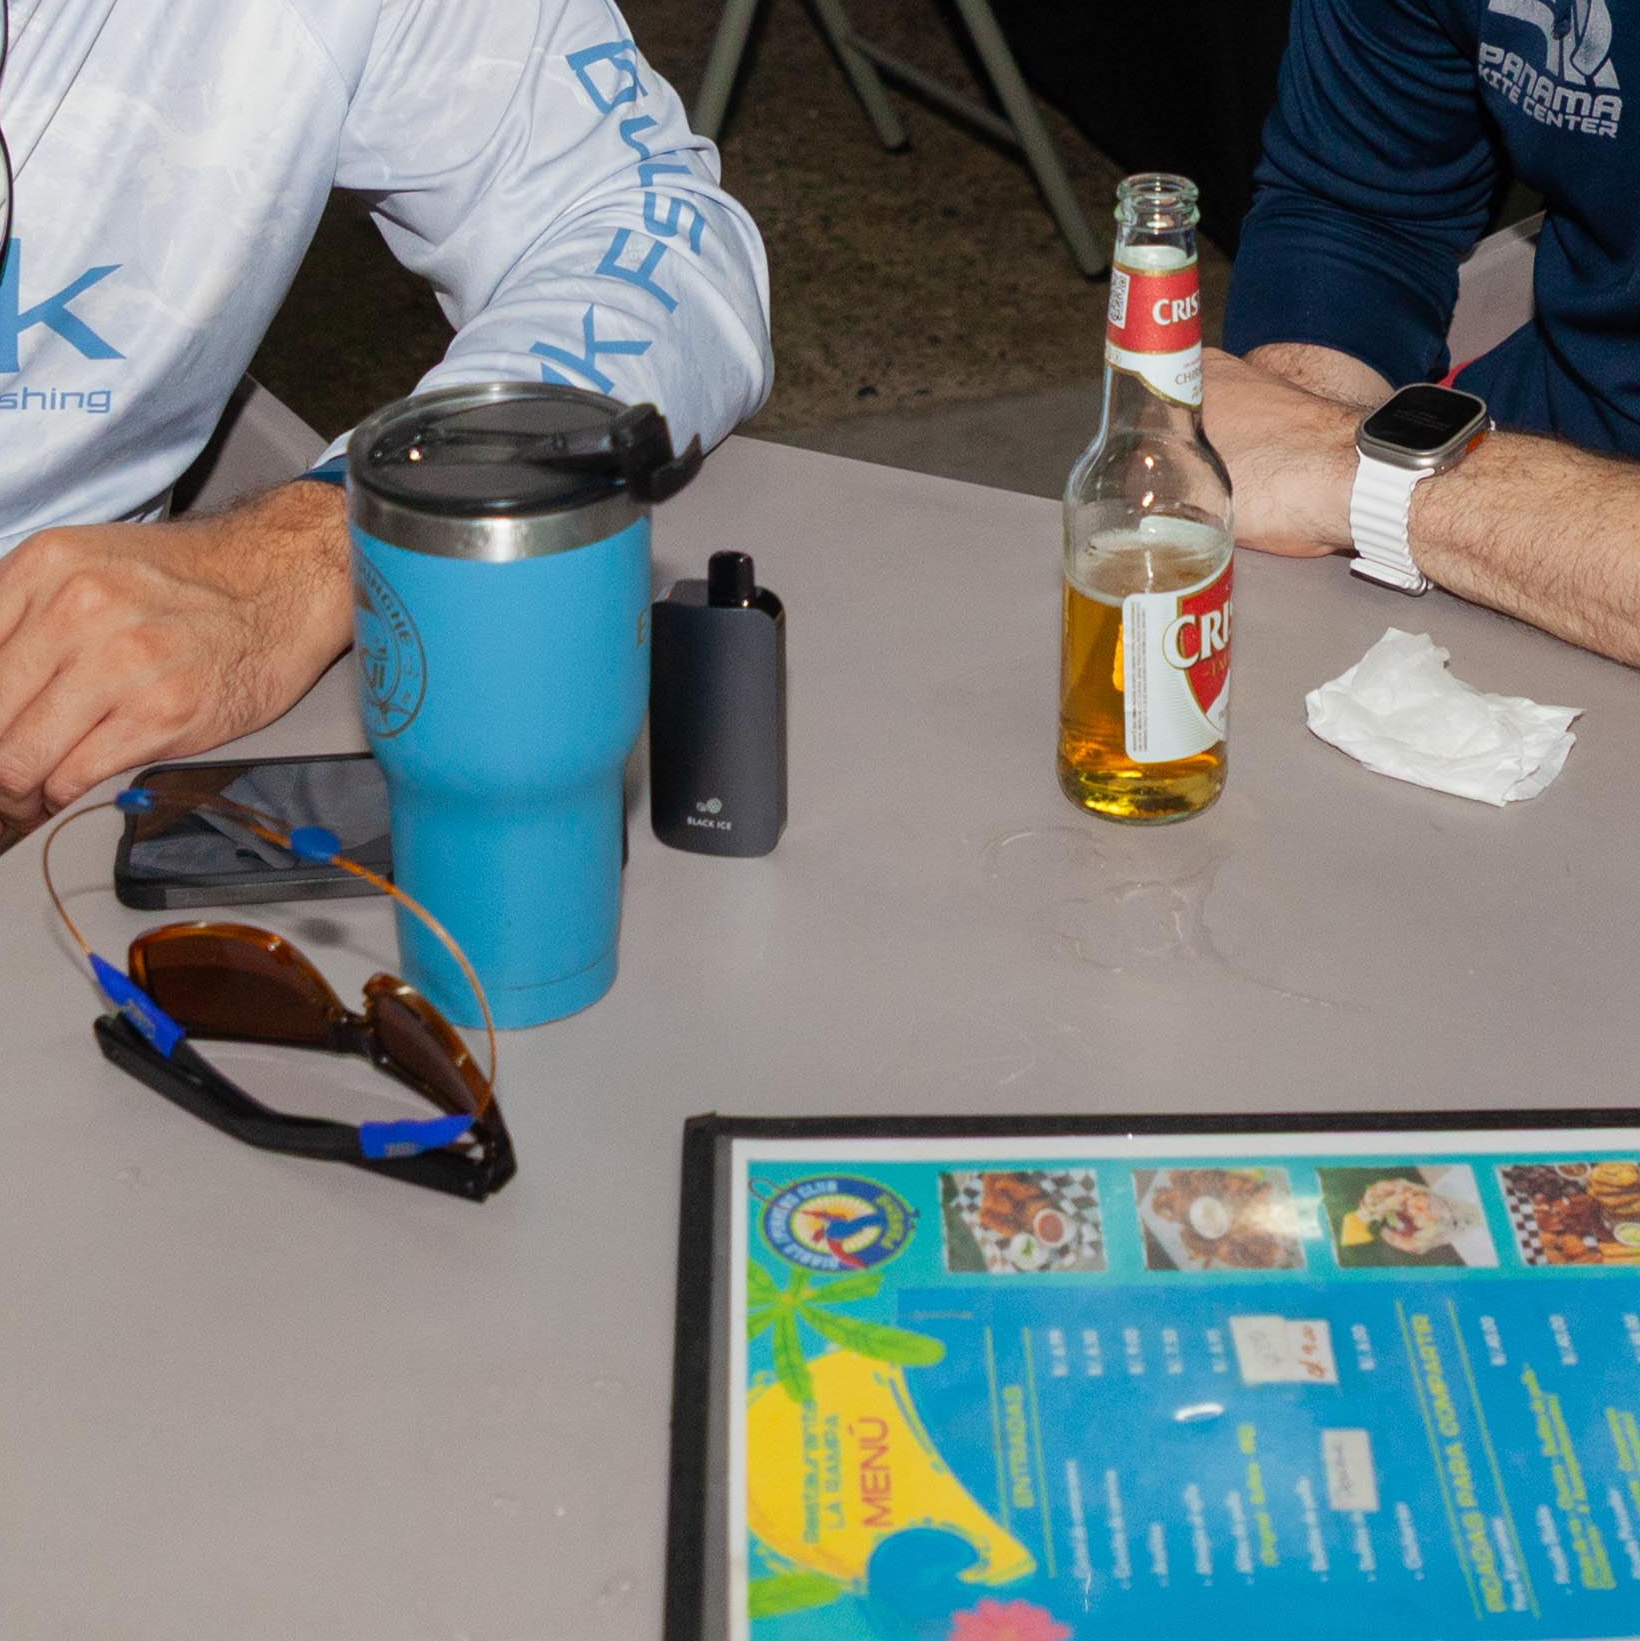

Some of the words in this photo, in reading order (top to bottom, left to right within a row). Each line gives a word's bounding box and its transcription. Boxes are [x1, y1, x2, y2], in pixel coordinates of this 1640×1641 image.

[1477, 63, 1522, 105] KITE
[1522, 96, 1619, 139] CENTER
[1478, 41, 1623, 121] PANAMA
[1152, 290, 1200, 326] CRIS
[1162, 601, 1232, 670] CRI
[687, 815, 716, 829] BLACK
[717, 821, 732, 831] ICE
[1411, 1313, 1461, 1437] COMPARTIR
[846, 1416, 895, 1528] MENÚ
[1003, 1385, 1035, 1509] ENTRADAS
[1441, 1441, 1481, 1507] PARA
[1459, 1509, 1509, 1612] PICADAS
